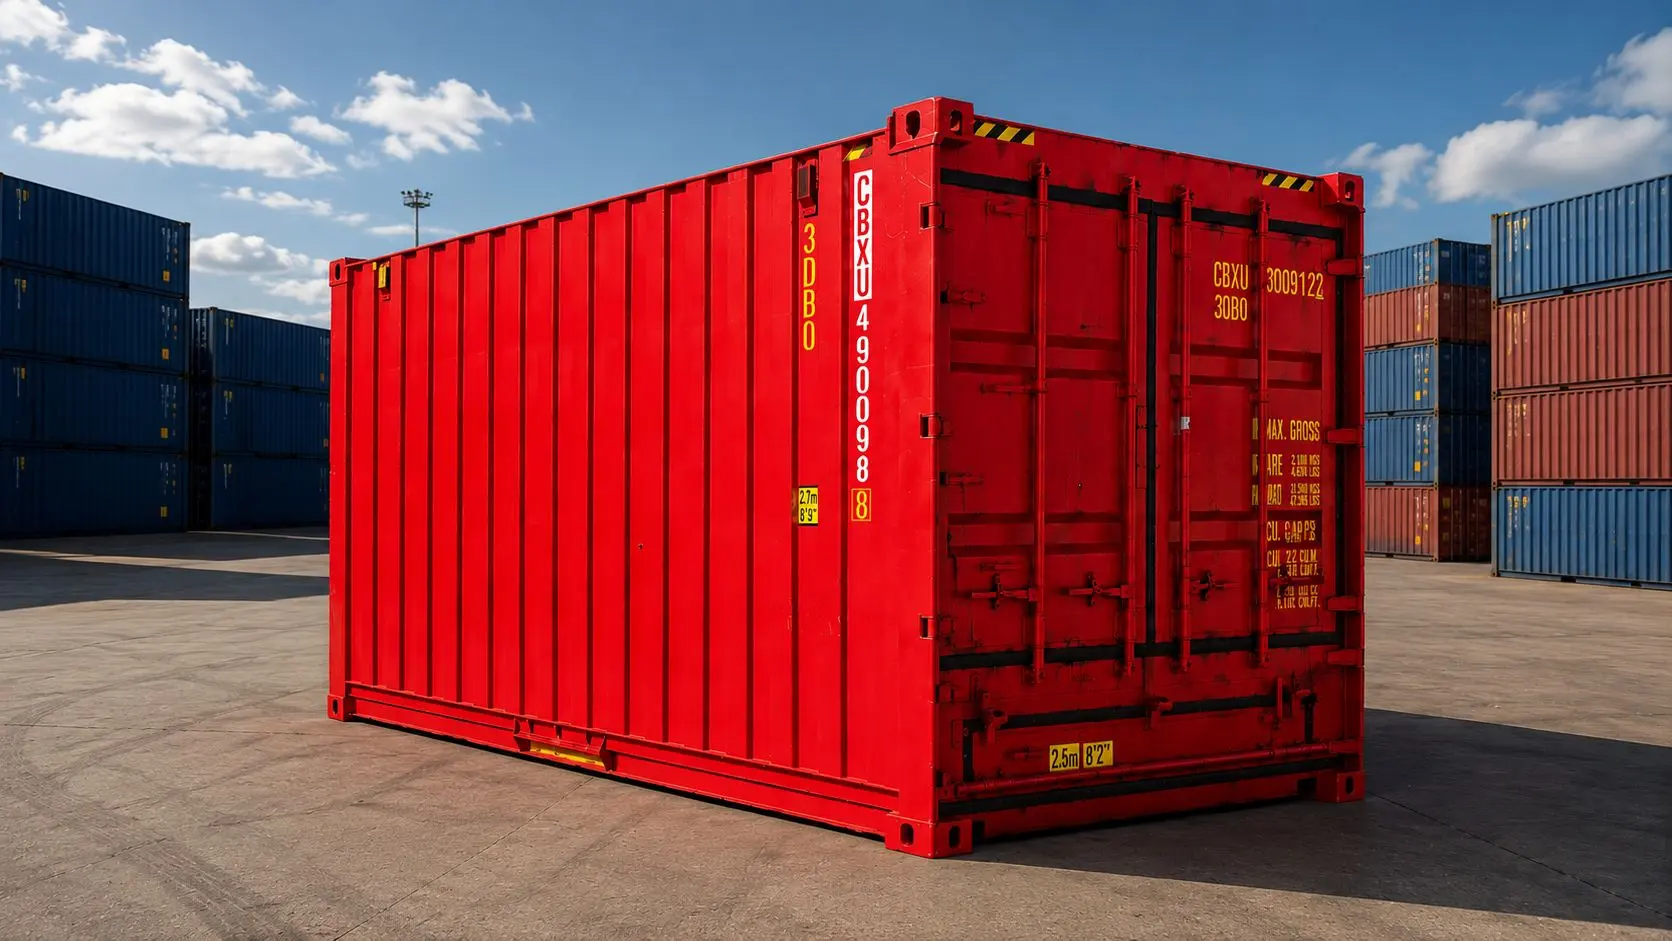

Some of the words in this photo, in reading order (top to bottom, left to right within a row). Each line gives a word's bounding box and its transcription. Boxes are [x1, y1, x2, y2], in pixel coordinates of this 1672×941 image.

[857, 174, 870, 297] CBXU
[1213, 261, 1249, 290] CBXU
[1266, 267, 1324, 298] 3009122
[856, 304, 870, 482] 490098
[1290, 419, 1320, 441] GROSS
[800, 489, 817, 504] 2.7m
[855, 490, 868, 519] 8
[1051, 748, 1079, 769] 2.5m
[1086, 743, 1110, 766] 8'2"
